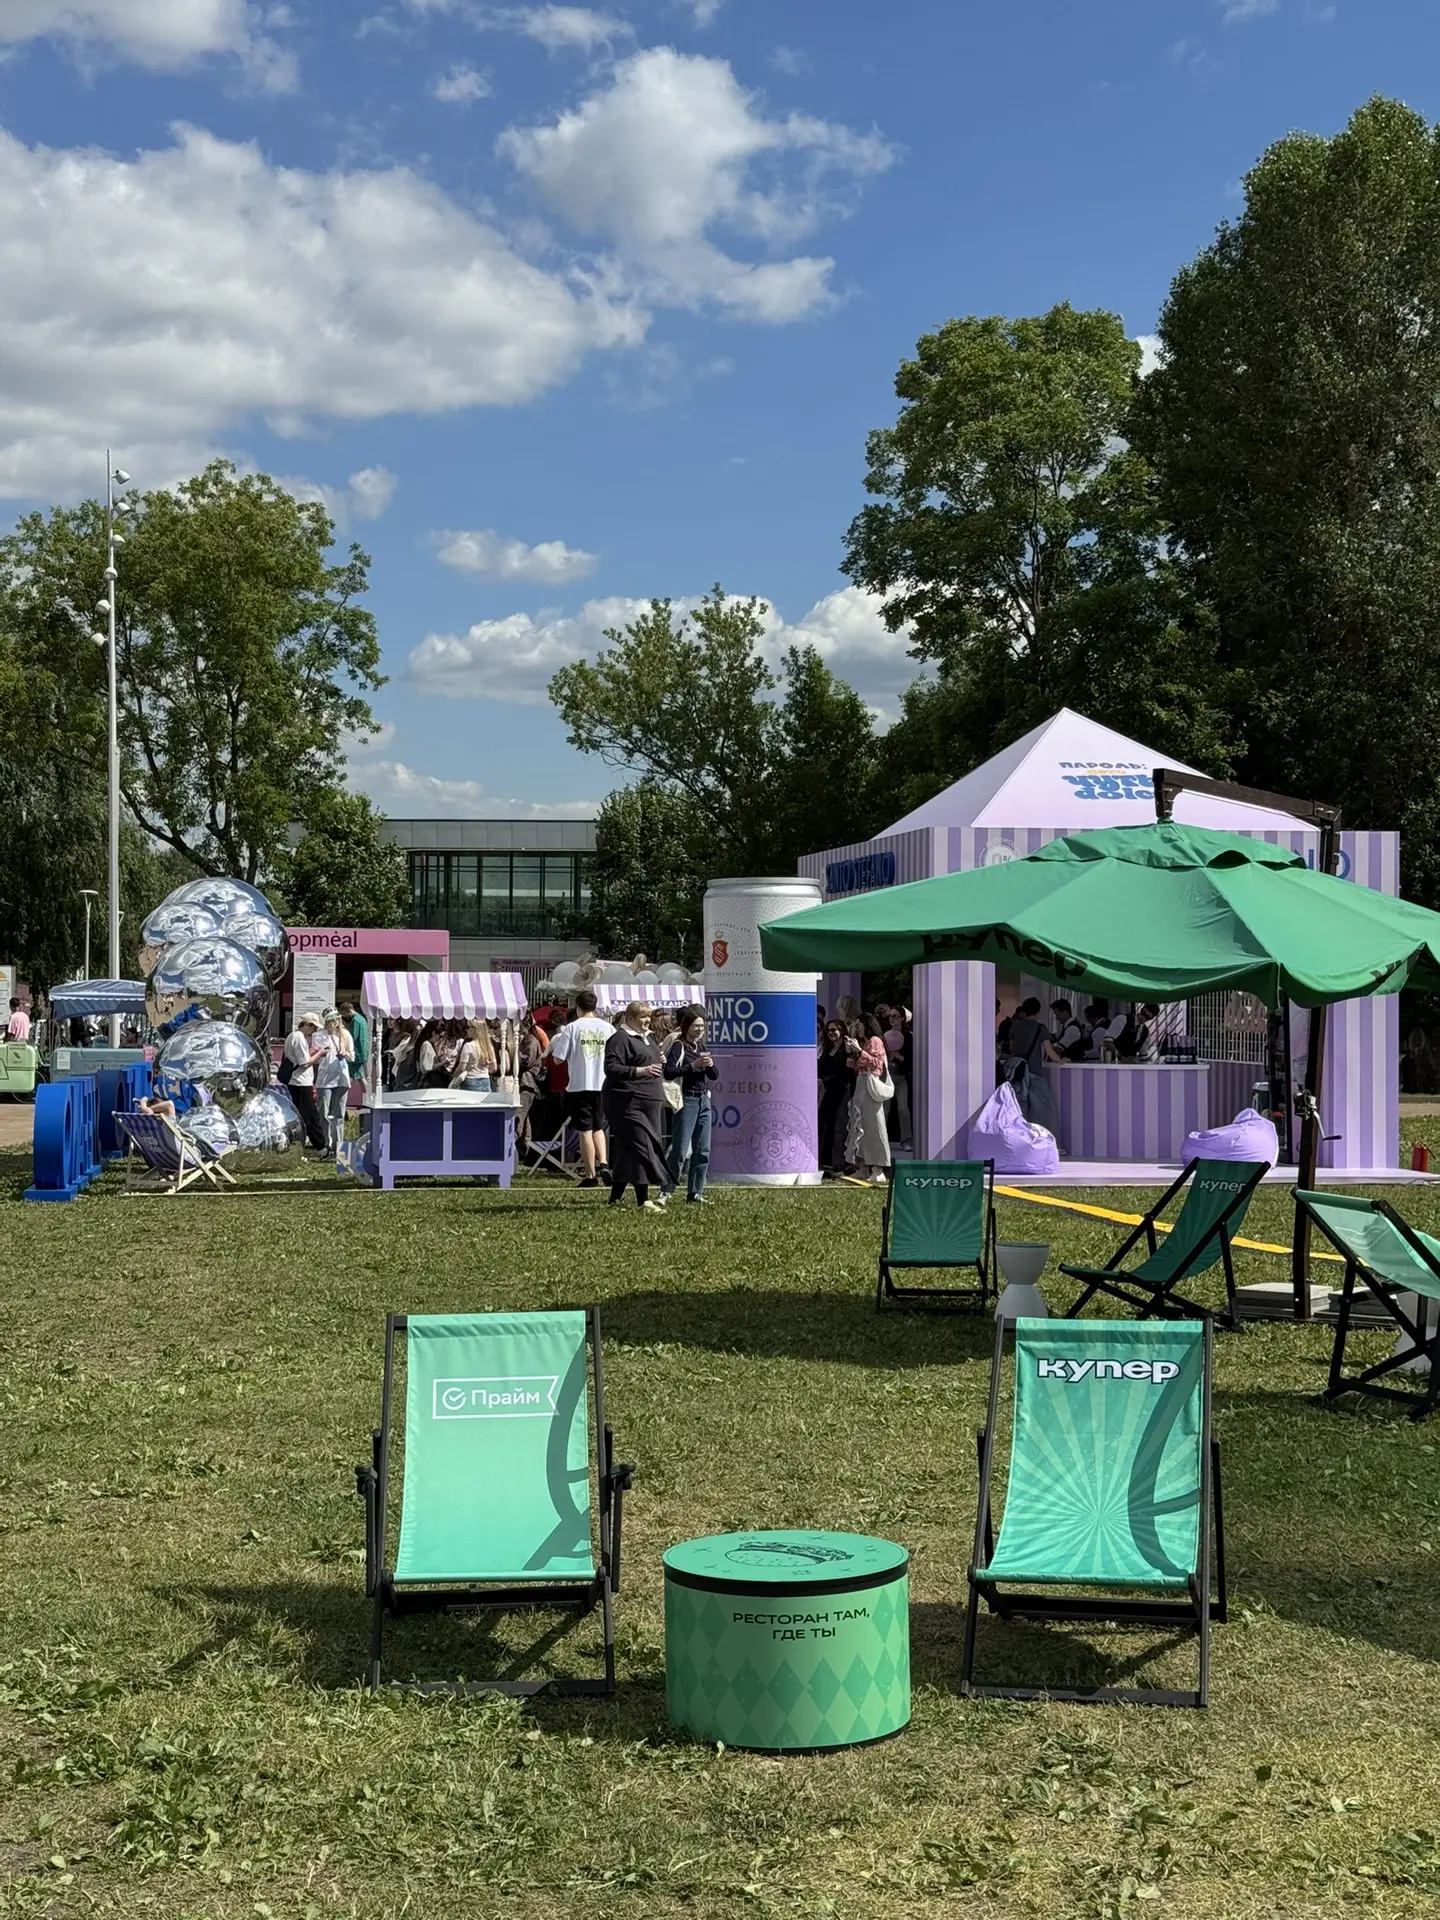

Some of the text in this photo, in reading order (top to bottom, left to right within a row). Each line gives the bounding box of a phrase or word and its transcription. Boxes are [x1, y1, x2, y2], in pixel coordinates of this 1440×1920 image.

[1074, 786, 1155, 800] dolc
[705, 996, 754, 1019] ANTO
[706, 1020, 769, 1043] EFANO
[728, 1081, 772, 1095] ZERO
[904, 1177, 974, 1190] купер
[1037, 1358, 1181, 1384] купер
[471, 1387, 540, 1409] Прайм
[732, 1607, 870, 1625] РЕСТОРАН ТАМ,
[772, 1627, 836, 1641] ГДЕ ТЫ
